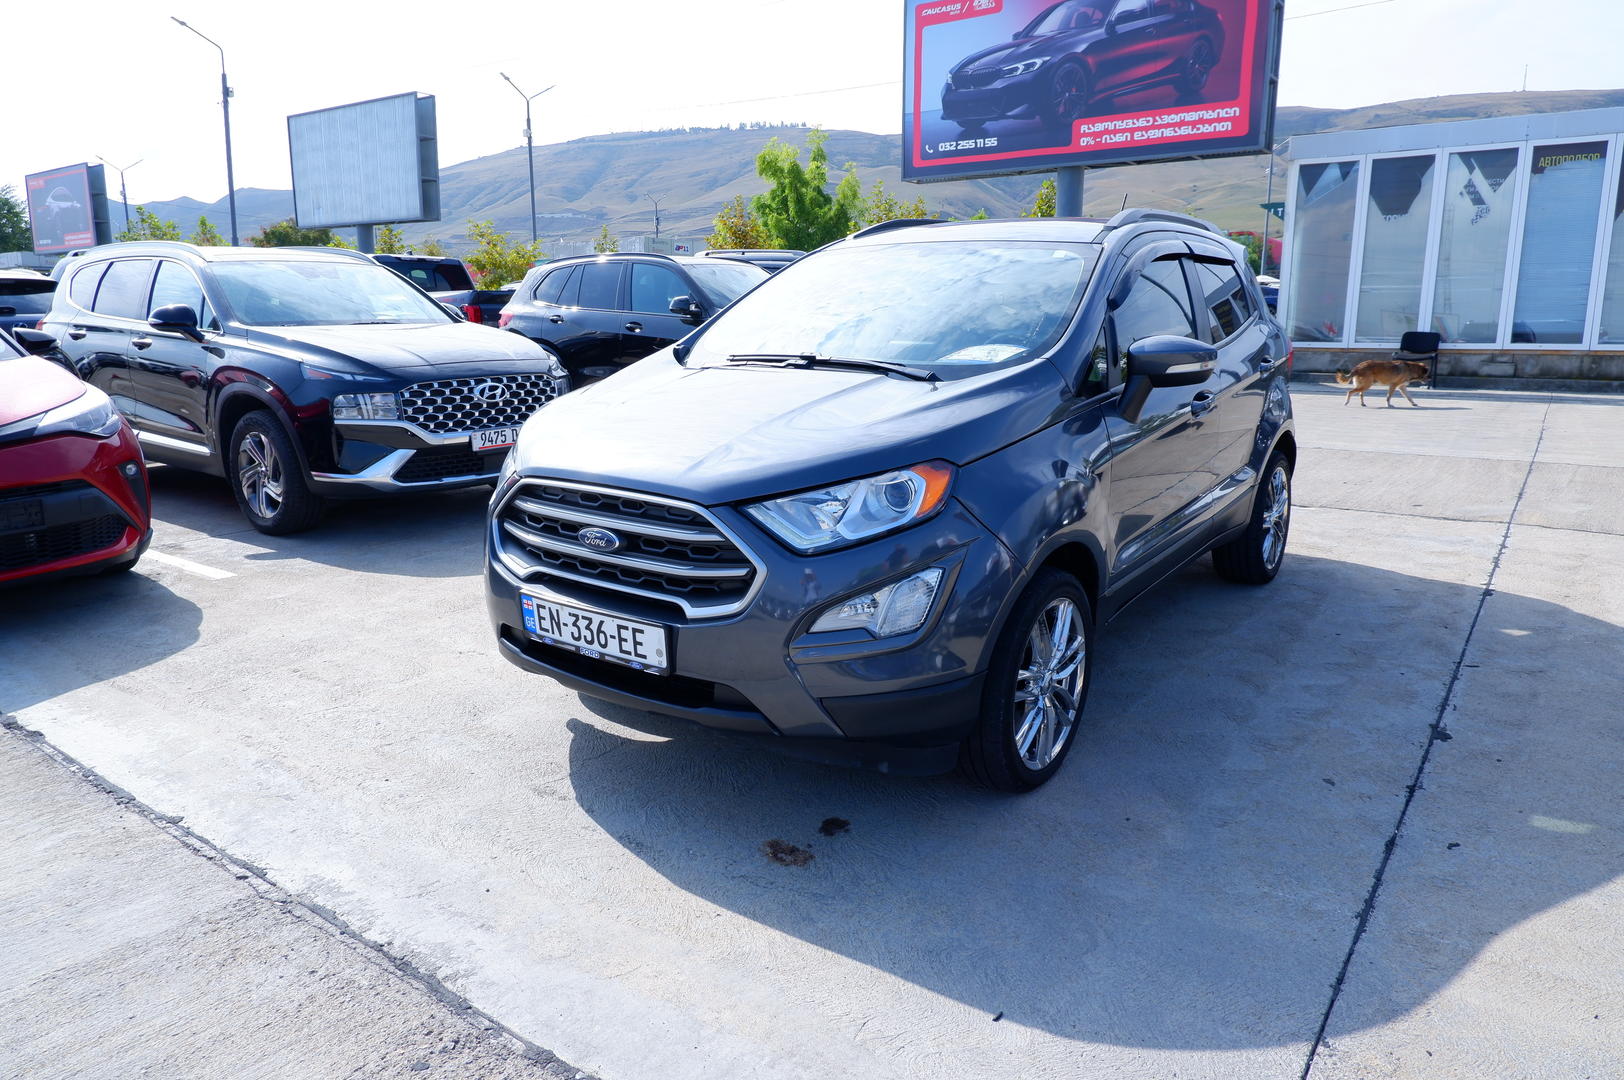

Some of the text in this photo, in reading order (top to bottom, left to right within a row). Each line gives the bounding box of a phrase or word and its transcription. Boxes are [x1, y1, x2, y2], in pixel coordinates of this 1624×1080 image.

[921, 3, 962, 16] CAUCASUS
[938, 137, 998, 151] 032 255 11 55
[480, 430, 507, 446] 9475
[584, 531, 607, 547] Ford
[525, 616, 536, 629] GE
[536, 603, 648, 660] EN-336-EE
[579, 647, 600, 659] FORD
